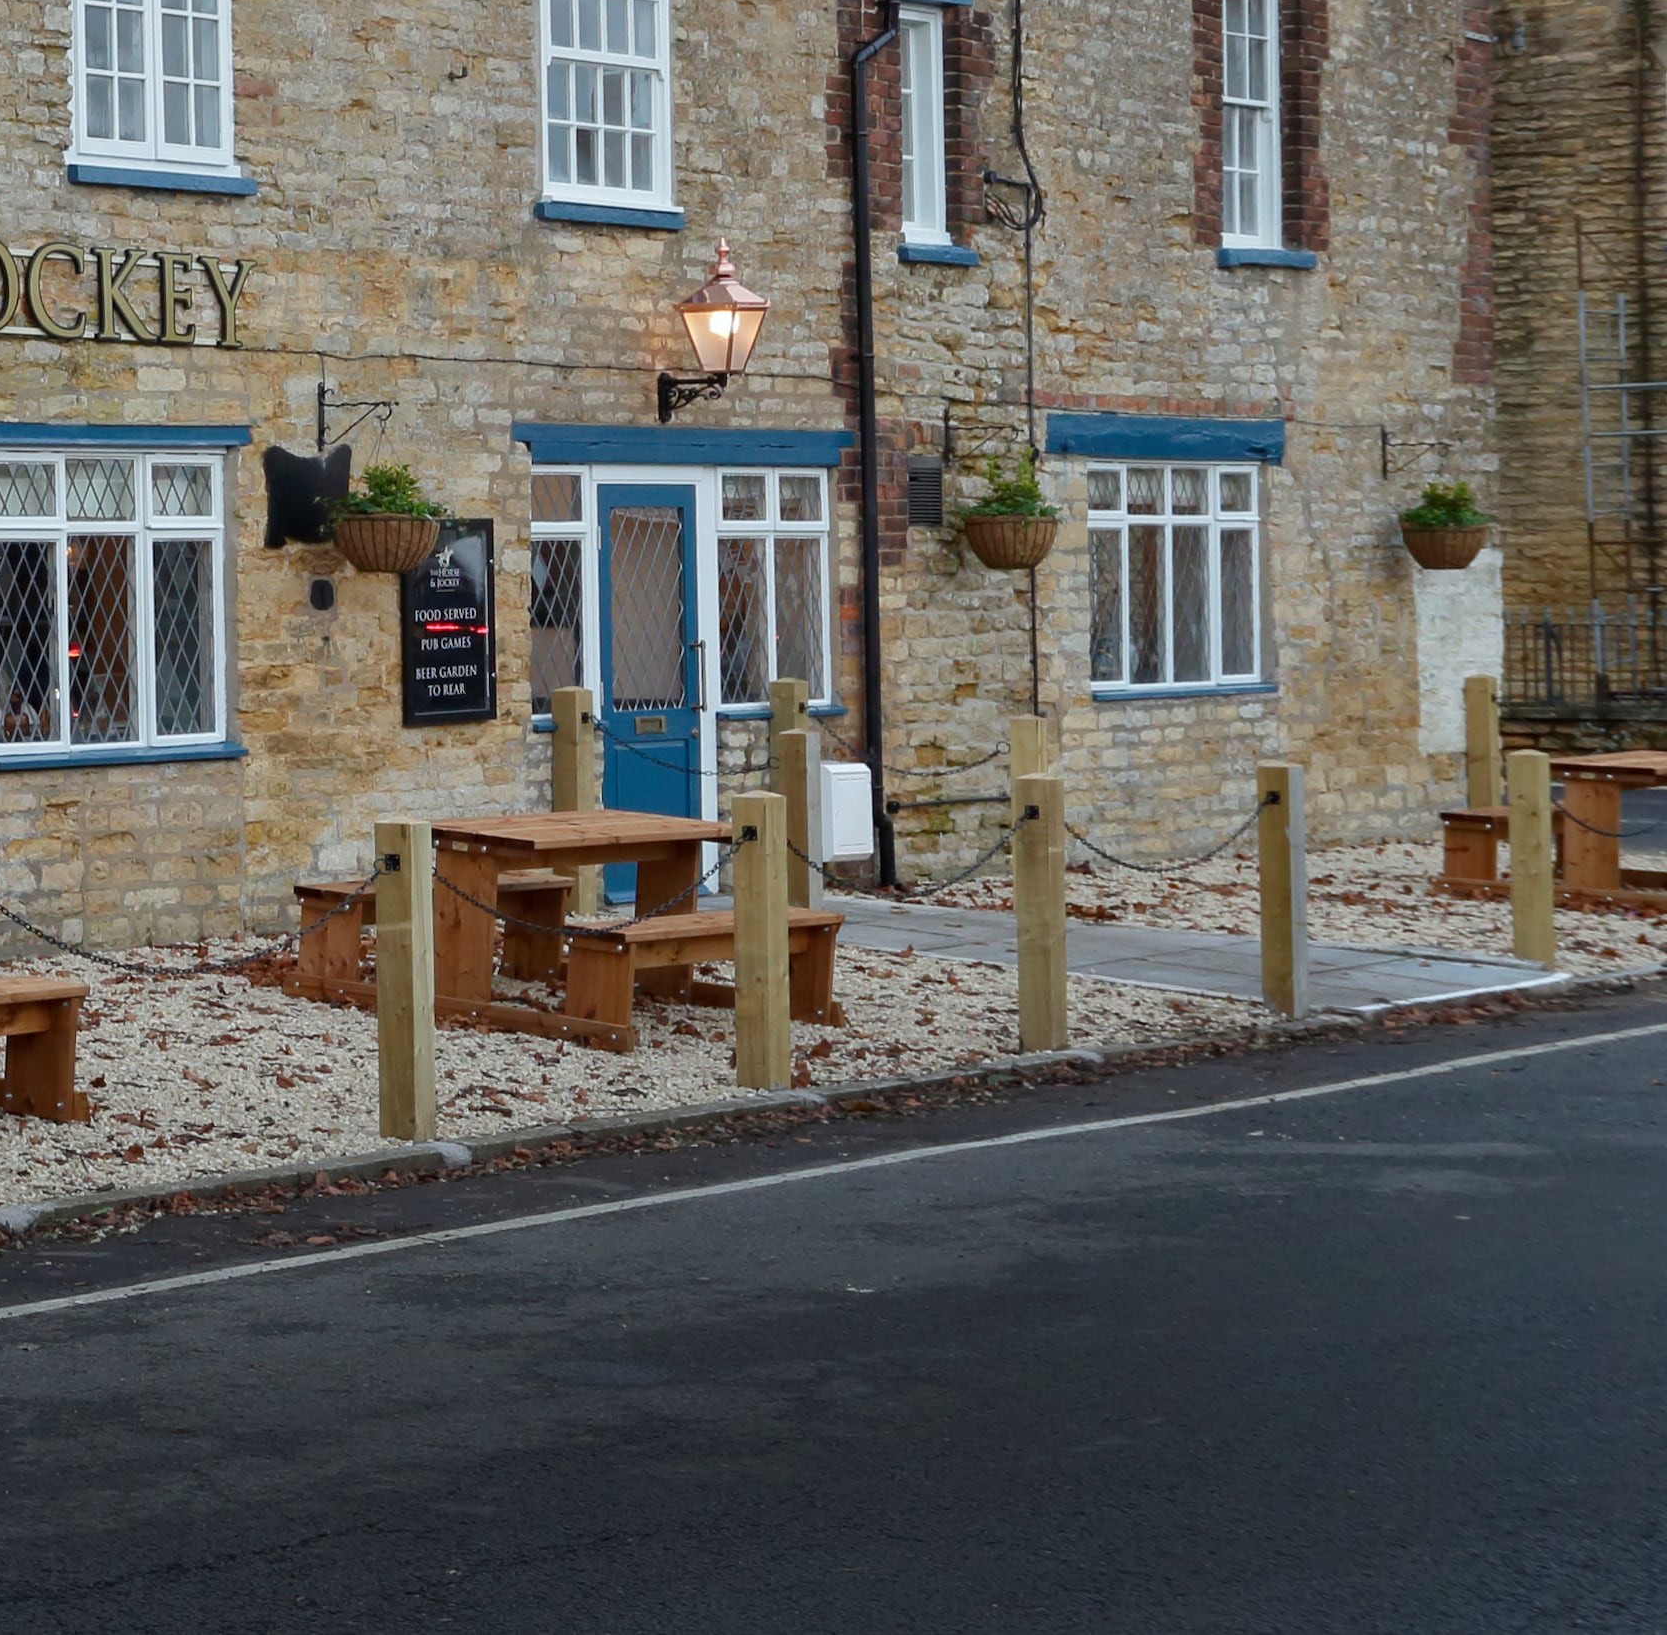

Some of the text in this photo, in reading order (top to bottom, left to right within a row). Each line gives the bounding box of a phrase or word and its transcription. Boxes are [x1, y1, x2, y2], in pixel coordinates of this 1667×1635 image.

[415, 607, 477, 622] FOOD SERVED
[421, 636, 472, 650] PUB GAMES
[415, 665, 477, 680] BEER GARDEN
[427, 683, 466, 697] TO REAR
